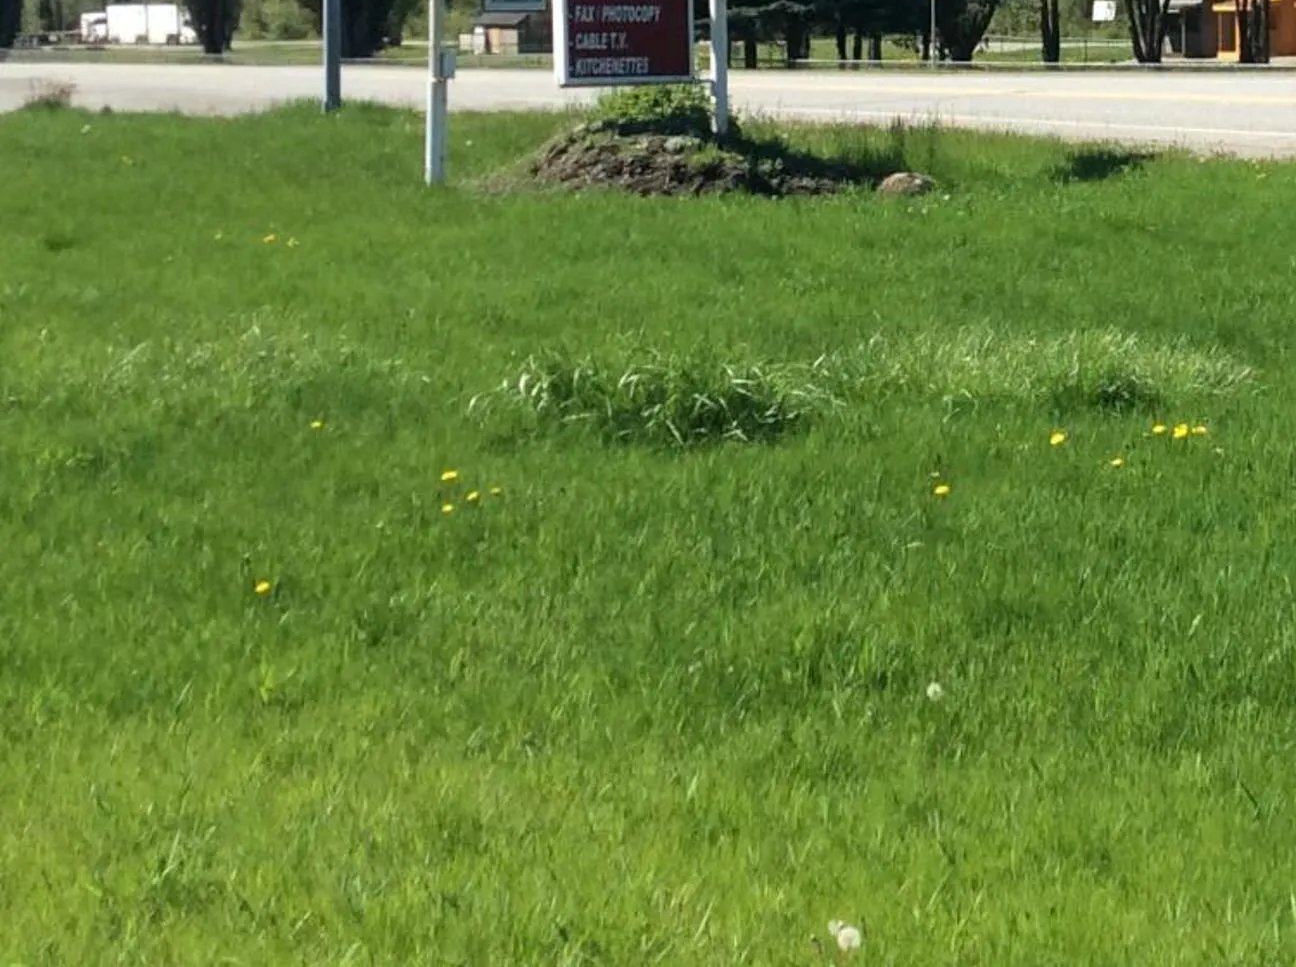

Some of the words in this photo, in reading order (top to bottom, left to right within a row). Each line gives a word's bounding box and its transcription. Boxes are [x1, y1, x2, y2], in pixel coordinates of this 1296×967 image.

[575, 5, 595, 22] FAX
[602, 5, 660, 23] PHOTOCOPY
[575, 32, 608, 50] CABLE
